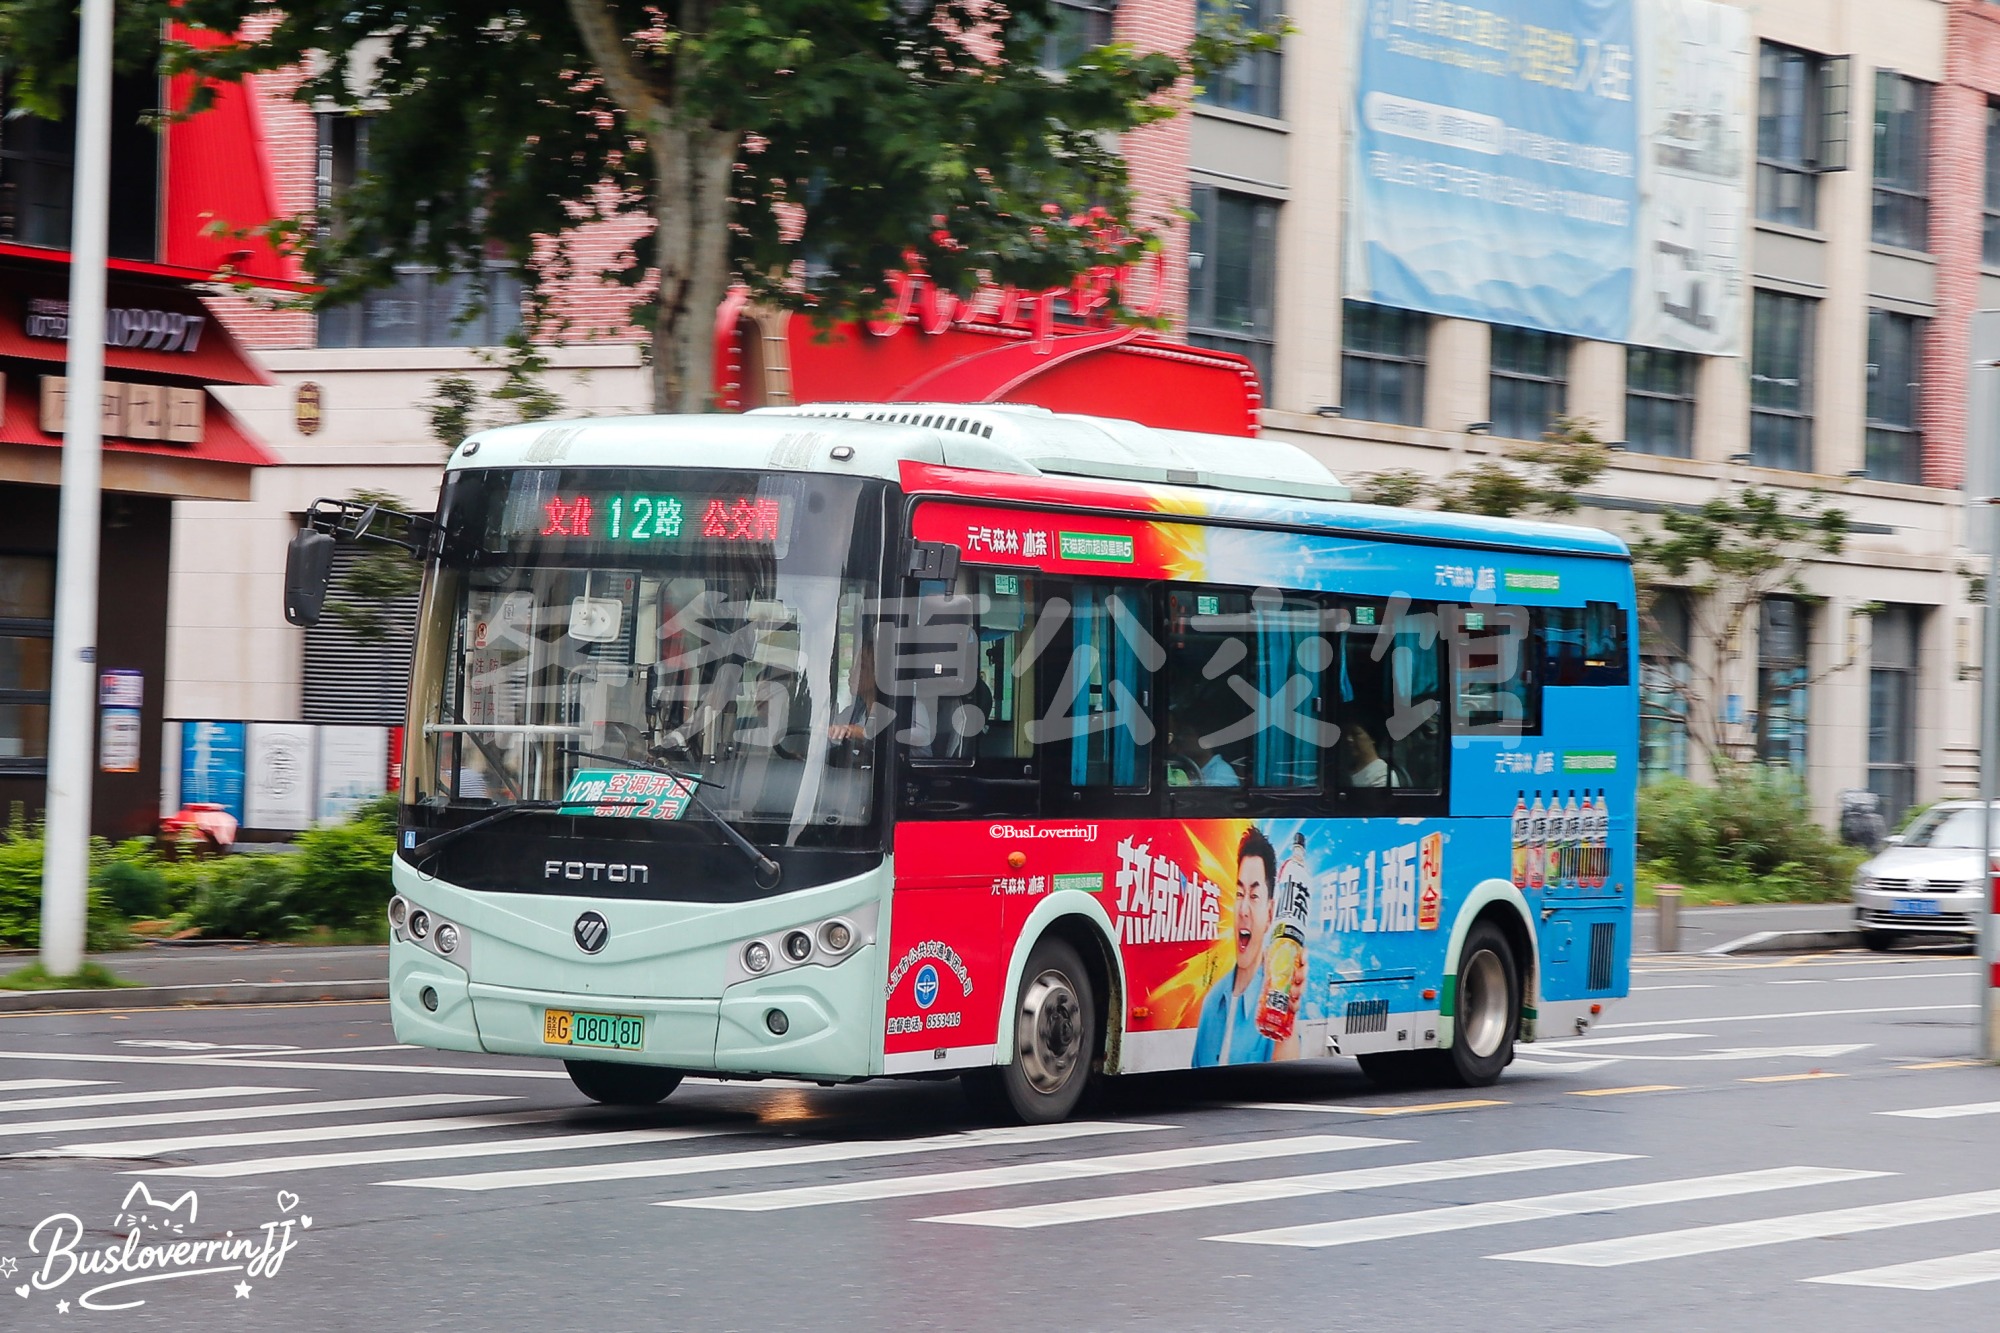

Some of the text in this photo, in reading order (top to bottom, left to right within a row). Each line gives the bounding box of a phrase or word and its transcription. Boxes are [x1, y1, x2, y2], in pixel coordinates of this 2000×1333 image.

[610, 498, 683, 539] 12路
[967, 526, 1019, 555] 元气森林
[1022, 529, 1048, 558] 冰茶
[606, 774, 693, 798] 空调开启
[544, 860, 649, 884] FOTON
[990, 877, 1026, 896] 元气森林
[1319, 841, 1418, 933] 再来1瓶
